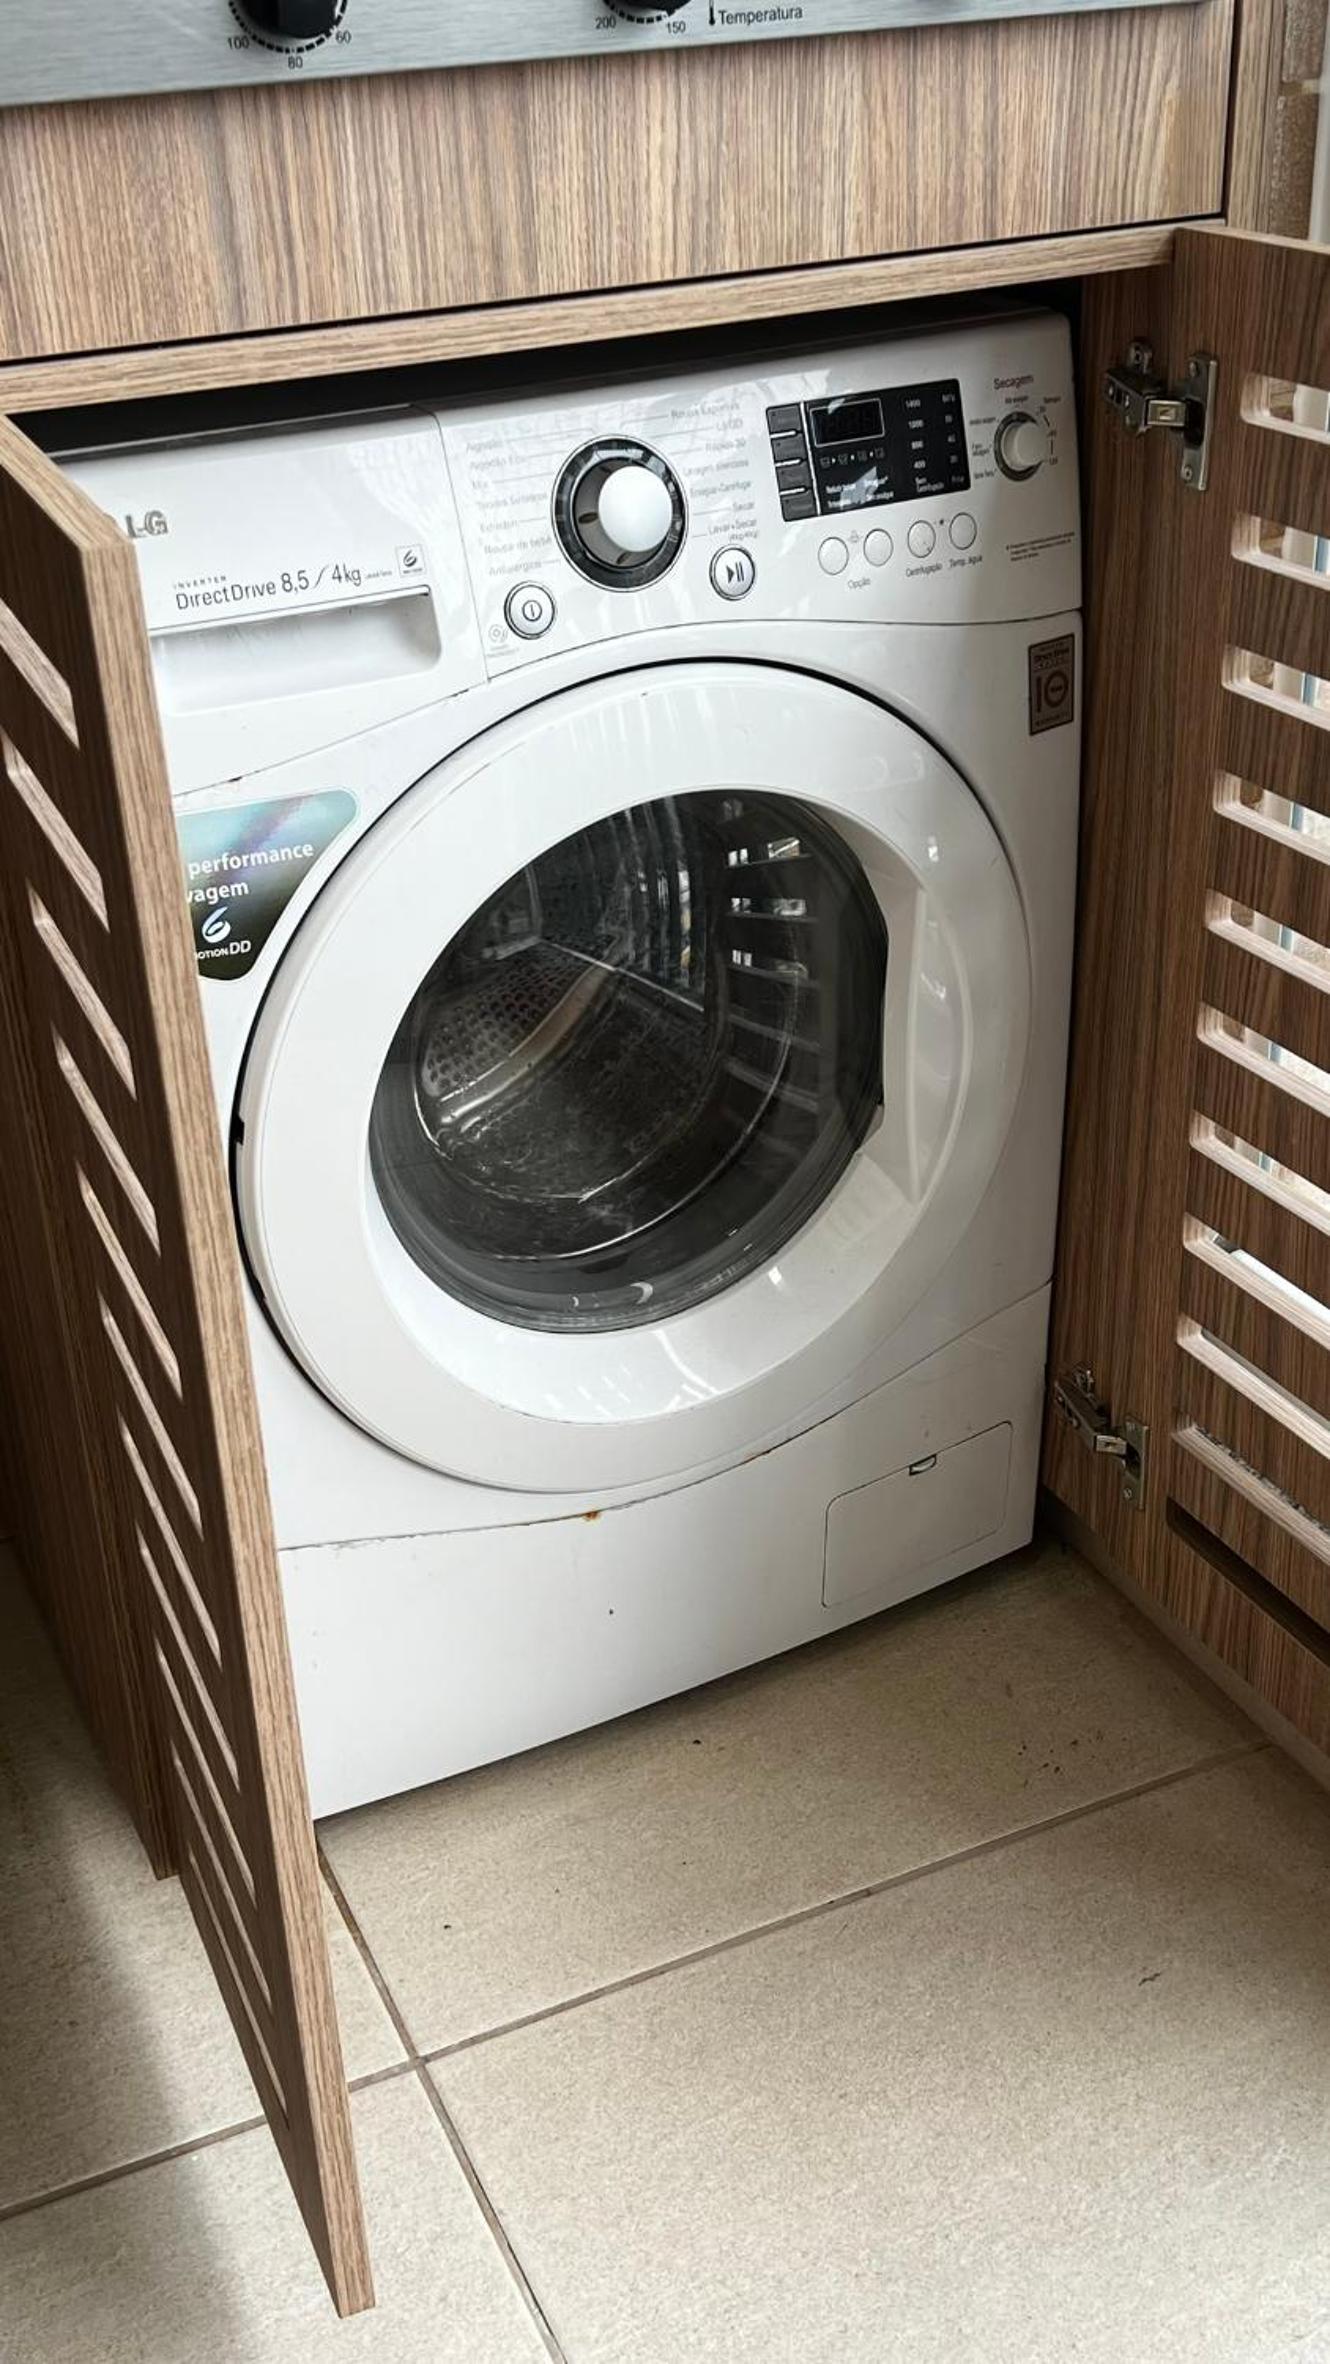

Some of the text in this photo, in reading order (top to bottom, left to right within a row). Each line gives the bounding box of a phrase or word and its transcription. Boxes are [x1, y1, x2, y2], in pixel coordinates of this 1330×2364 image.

[594, 15, 617, 30] 200
[718, 5, 804, 28] Temperatura
[666, 20, 686, 34] 150
[227, 36, 250, 51] 100
[335, 30, 352, 44] 60
[287, 56, 304, 70] 80
[994, 375, 1034, 391] Secagem
[125, 509, 168, 539] LG
[280, 569, 310, 595] 8,5
[332, 562, 362, 587] 4kg
[188, 842, 315, 880] performance
